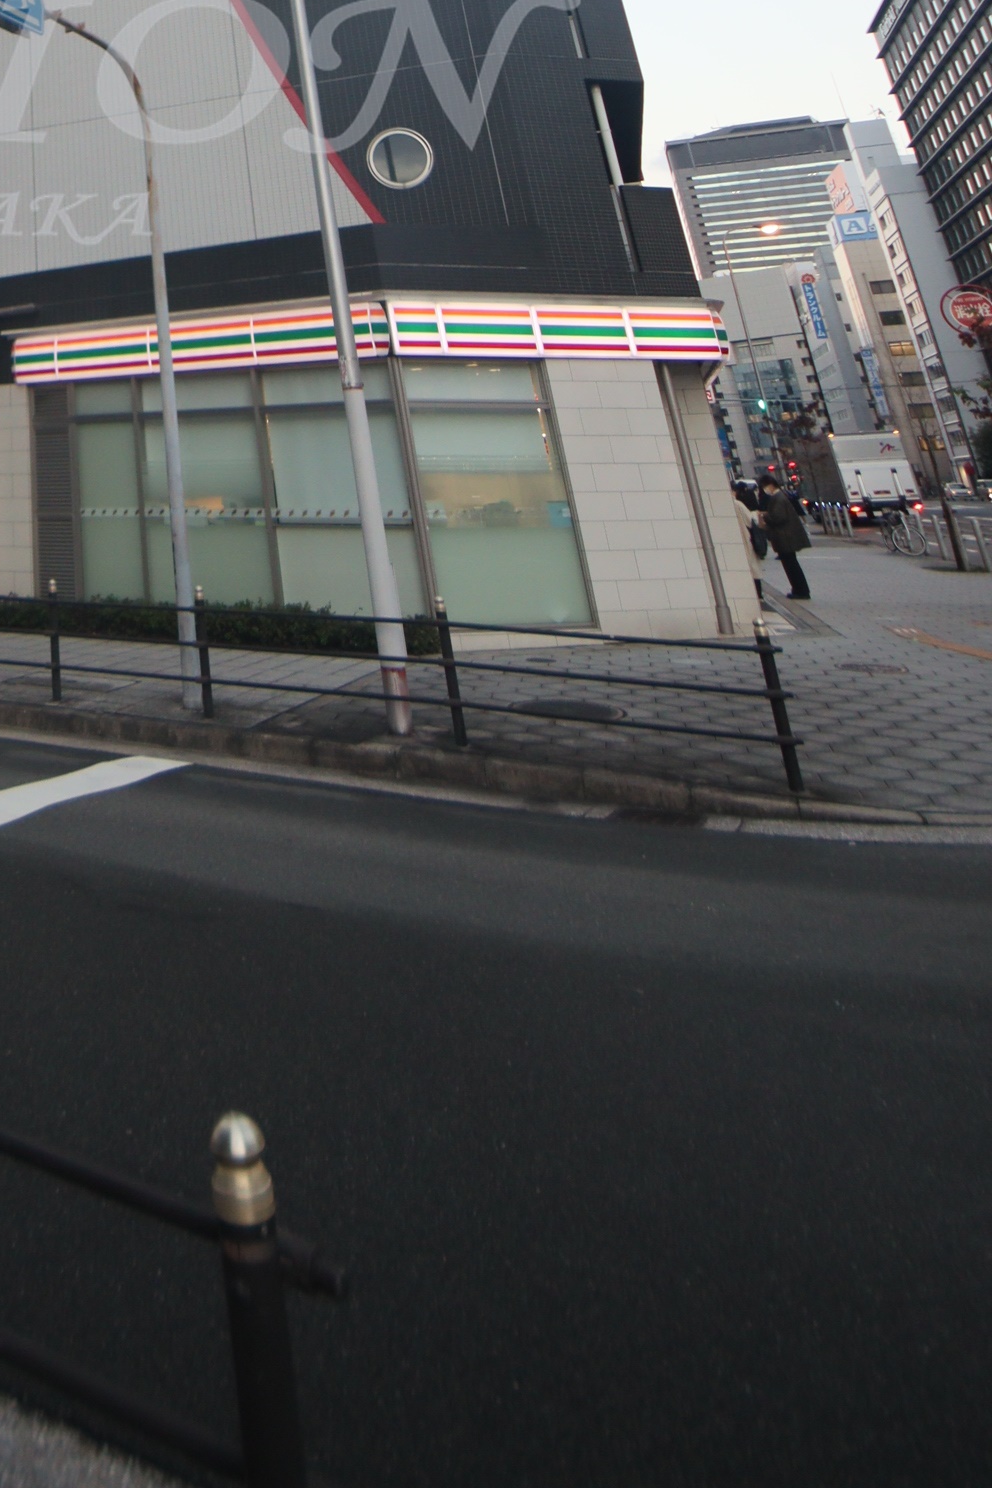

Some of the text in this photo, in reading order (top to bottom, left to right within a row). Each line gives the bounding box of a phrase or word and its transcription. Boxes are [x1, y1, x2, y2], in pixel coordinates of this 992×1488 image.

[804, 284, 826, 337] トランクルーム
